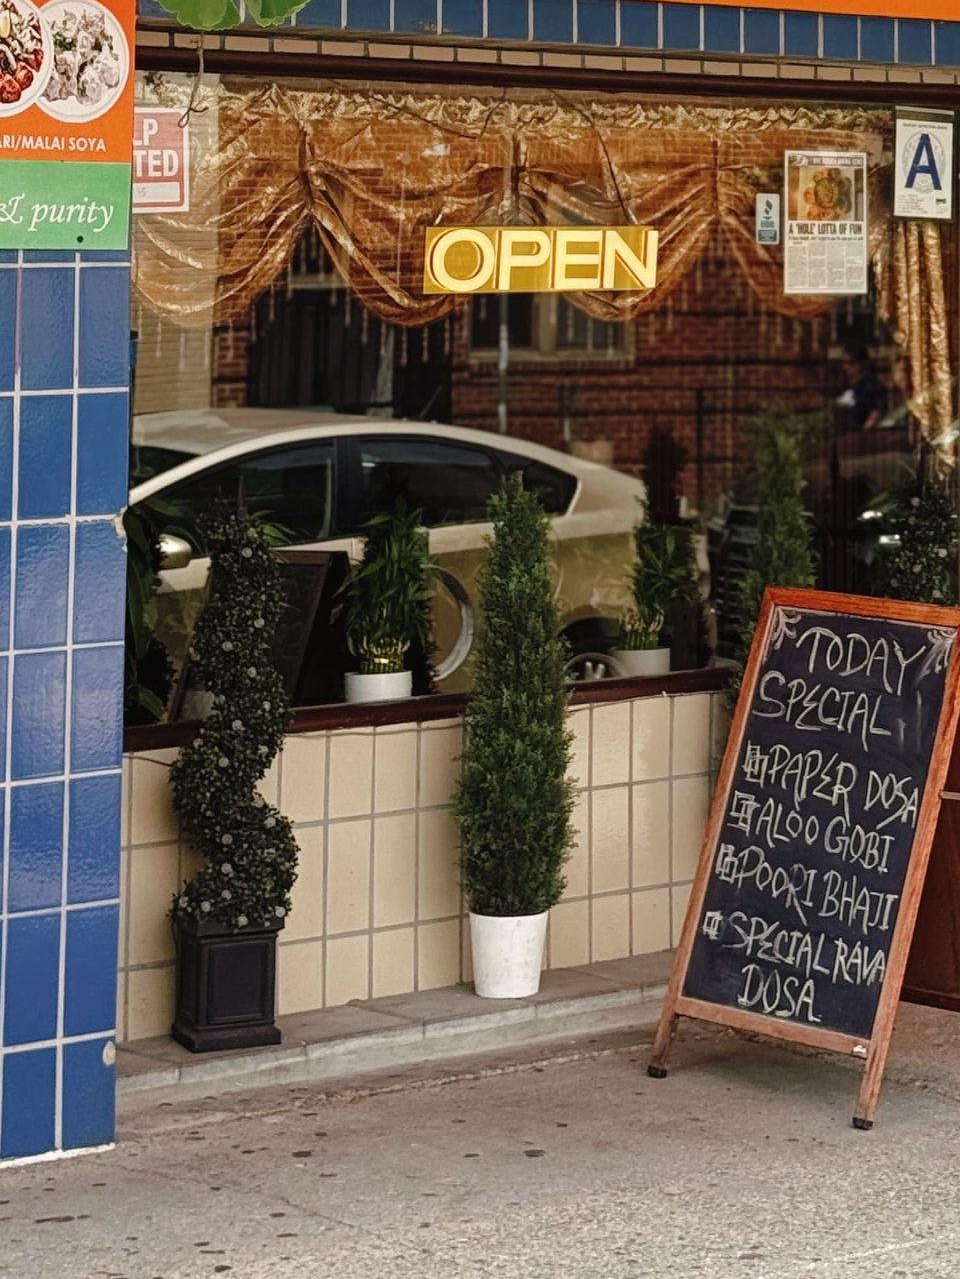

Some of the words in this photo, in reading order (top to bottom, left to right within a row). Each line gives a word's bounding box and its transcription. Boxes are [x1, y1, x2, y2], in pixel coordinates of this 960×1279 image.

[68, 137, 107, 153] SOYA
[904, 133, 942, 190] A
[27, 196, 114, 233] purity
[849, 223, 863, 236] FUN
[428, 227, 659, 292] OPEN
[796, 626, 926, 696] TODAY
[752, 671, 892, 752] SPECIAL
[768, 744, 855, 827] PAPER
[864, 770, 920, 830] DOSA
[756, 797, 819, 849] ALOO
[824, 817, 895, 874] GOBI
[737, 846, 815, 925] POORI
[823, 870, 899, 935] BHAJI
[722, 911, 831, 974] SPECIAL
[833, 937, 886, 987] RAVA
[737, 965, 822, 1022] DOSA
